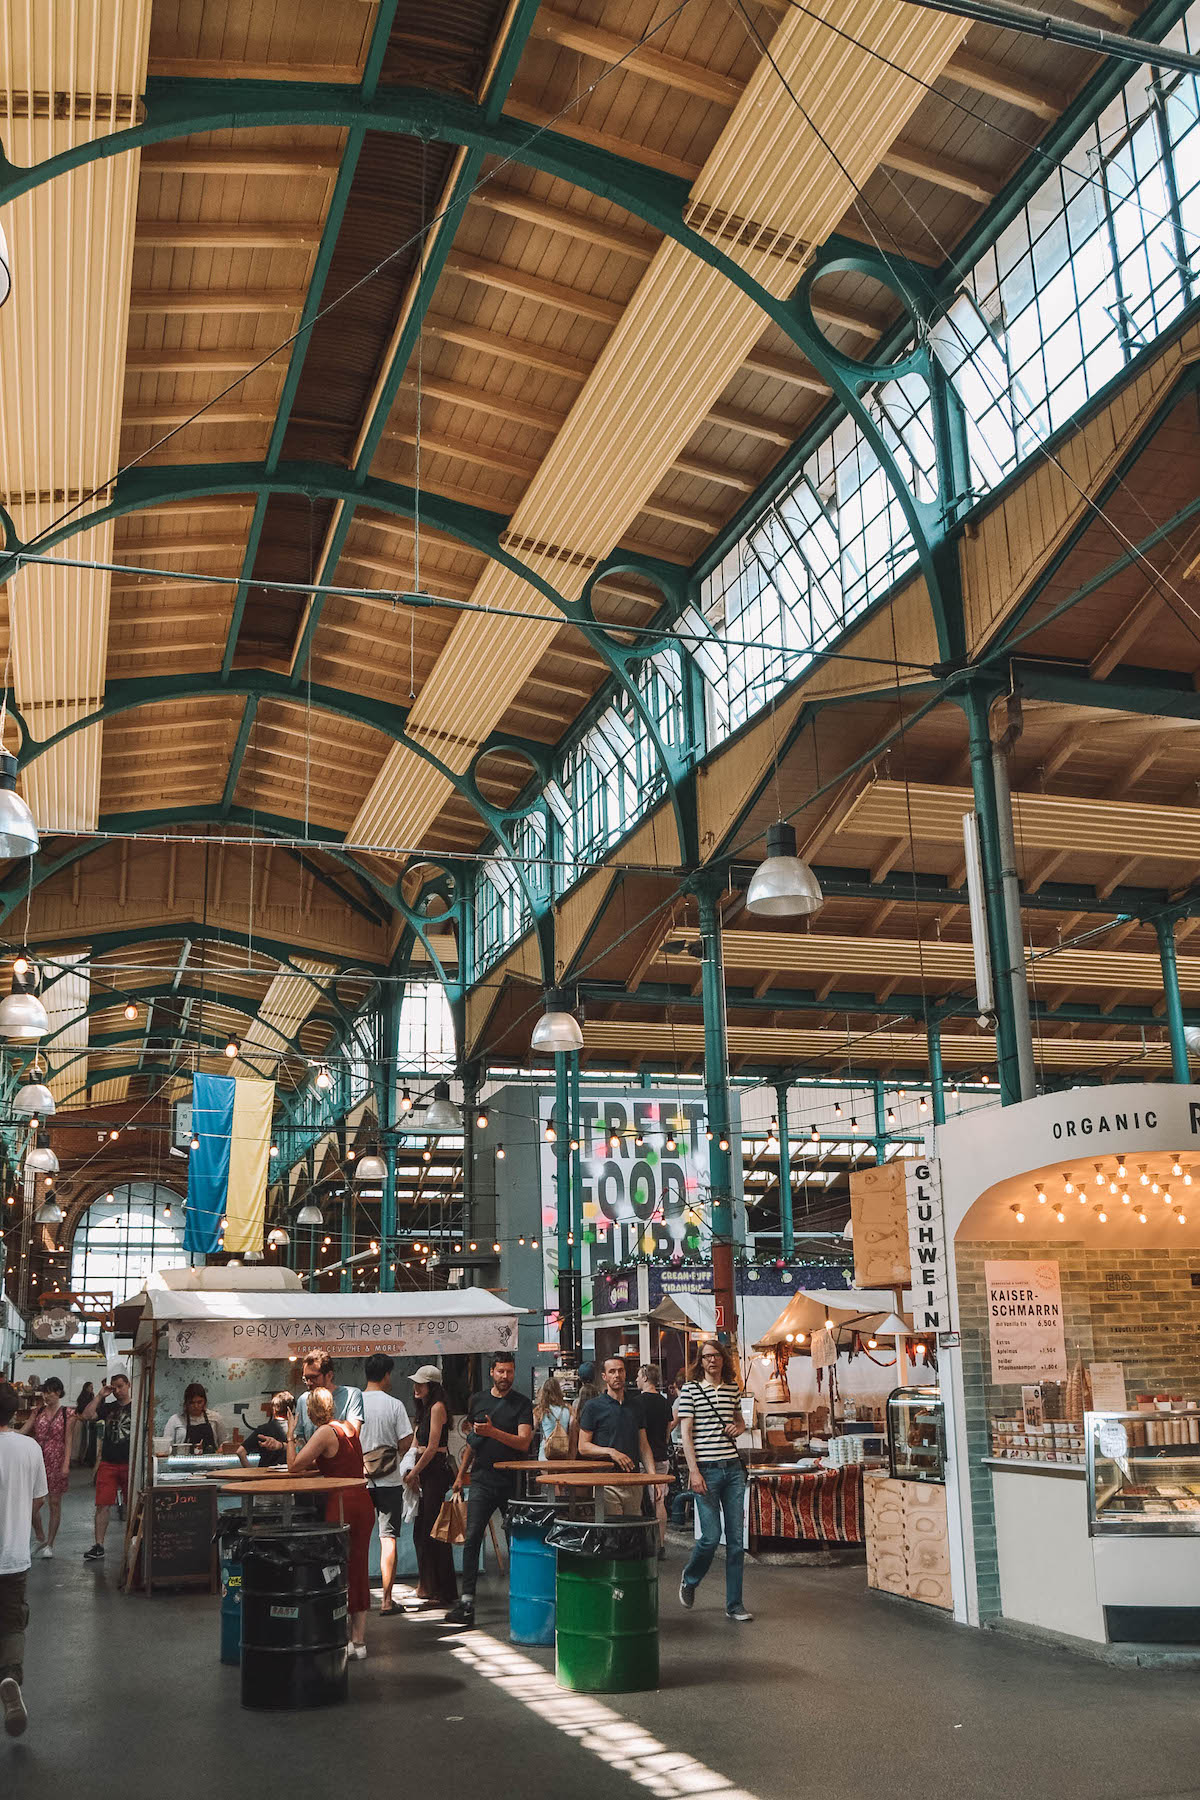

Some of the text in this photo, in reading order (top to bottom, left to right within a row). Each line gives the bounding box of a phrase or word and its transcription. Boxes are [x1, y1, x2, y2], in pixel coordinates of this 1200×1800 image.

[1053, 1111, 1157, 1139] ORGANIC
[579, 1161, 686, 1221] FOOD
[1105, 1273, 1132, 1291] EIS
[991, 1290, 1038, 1301] KAISER-
[992, 1305, 1059, 1316] SCHMARRN
